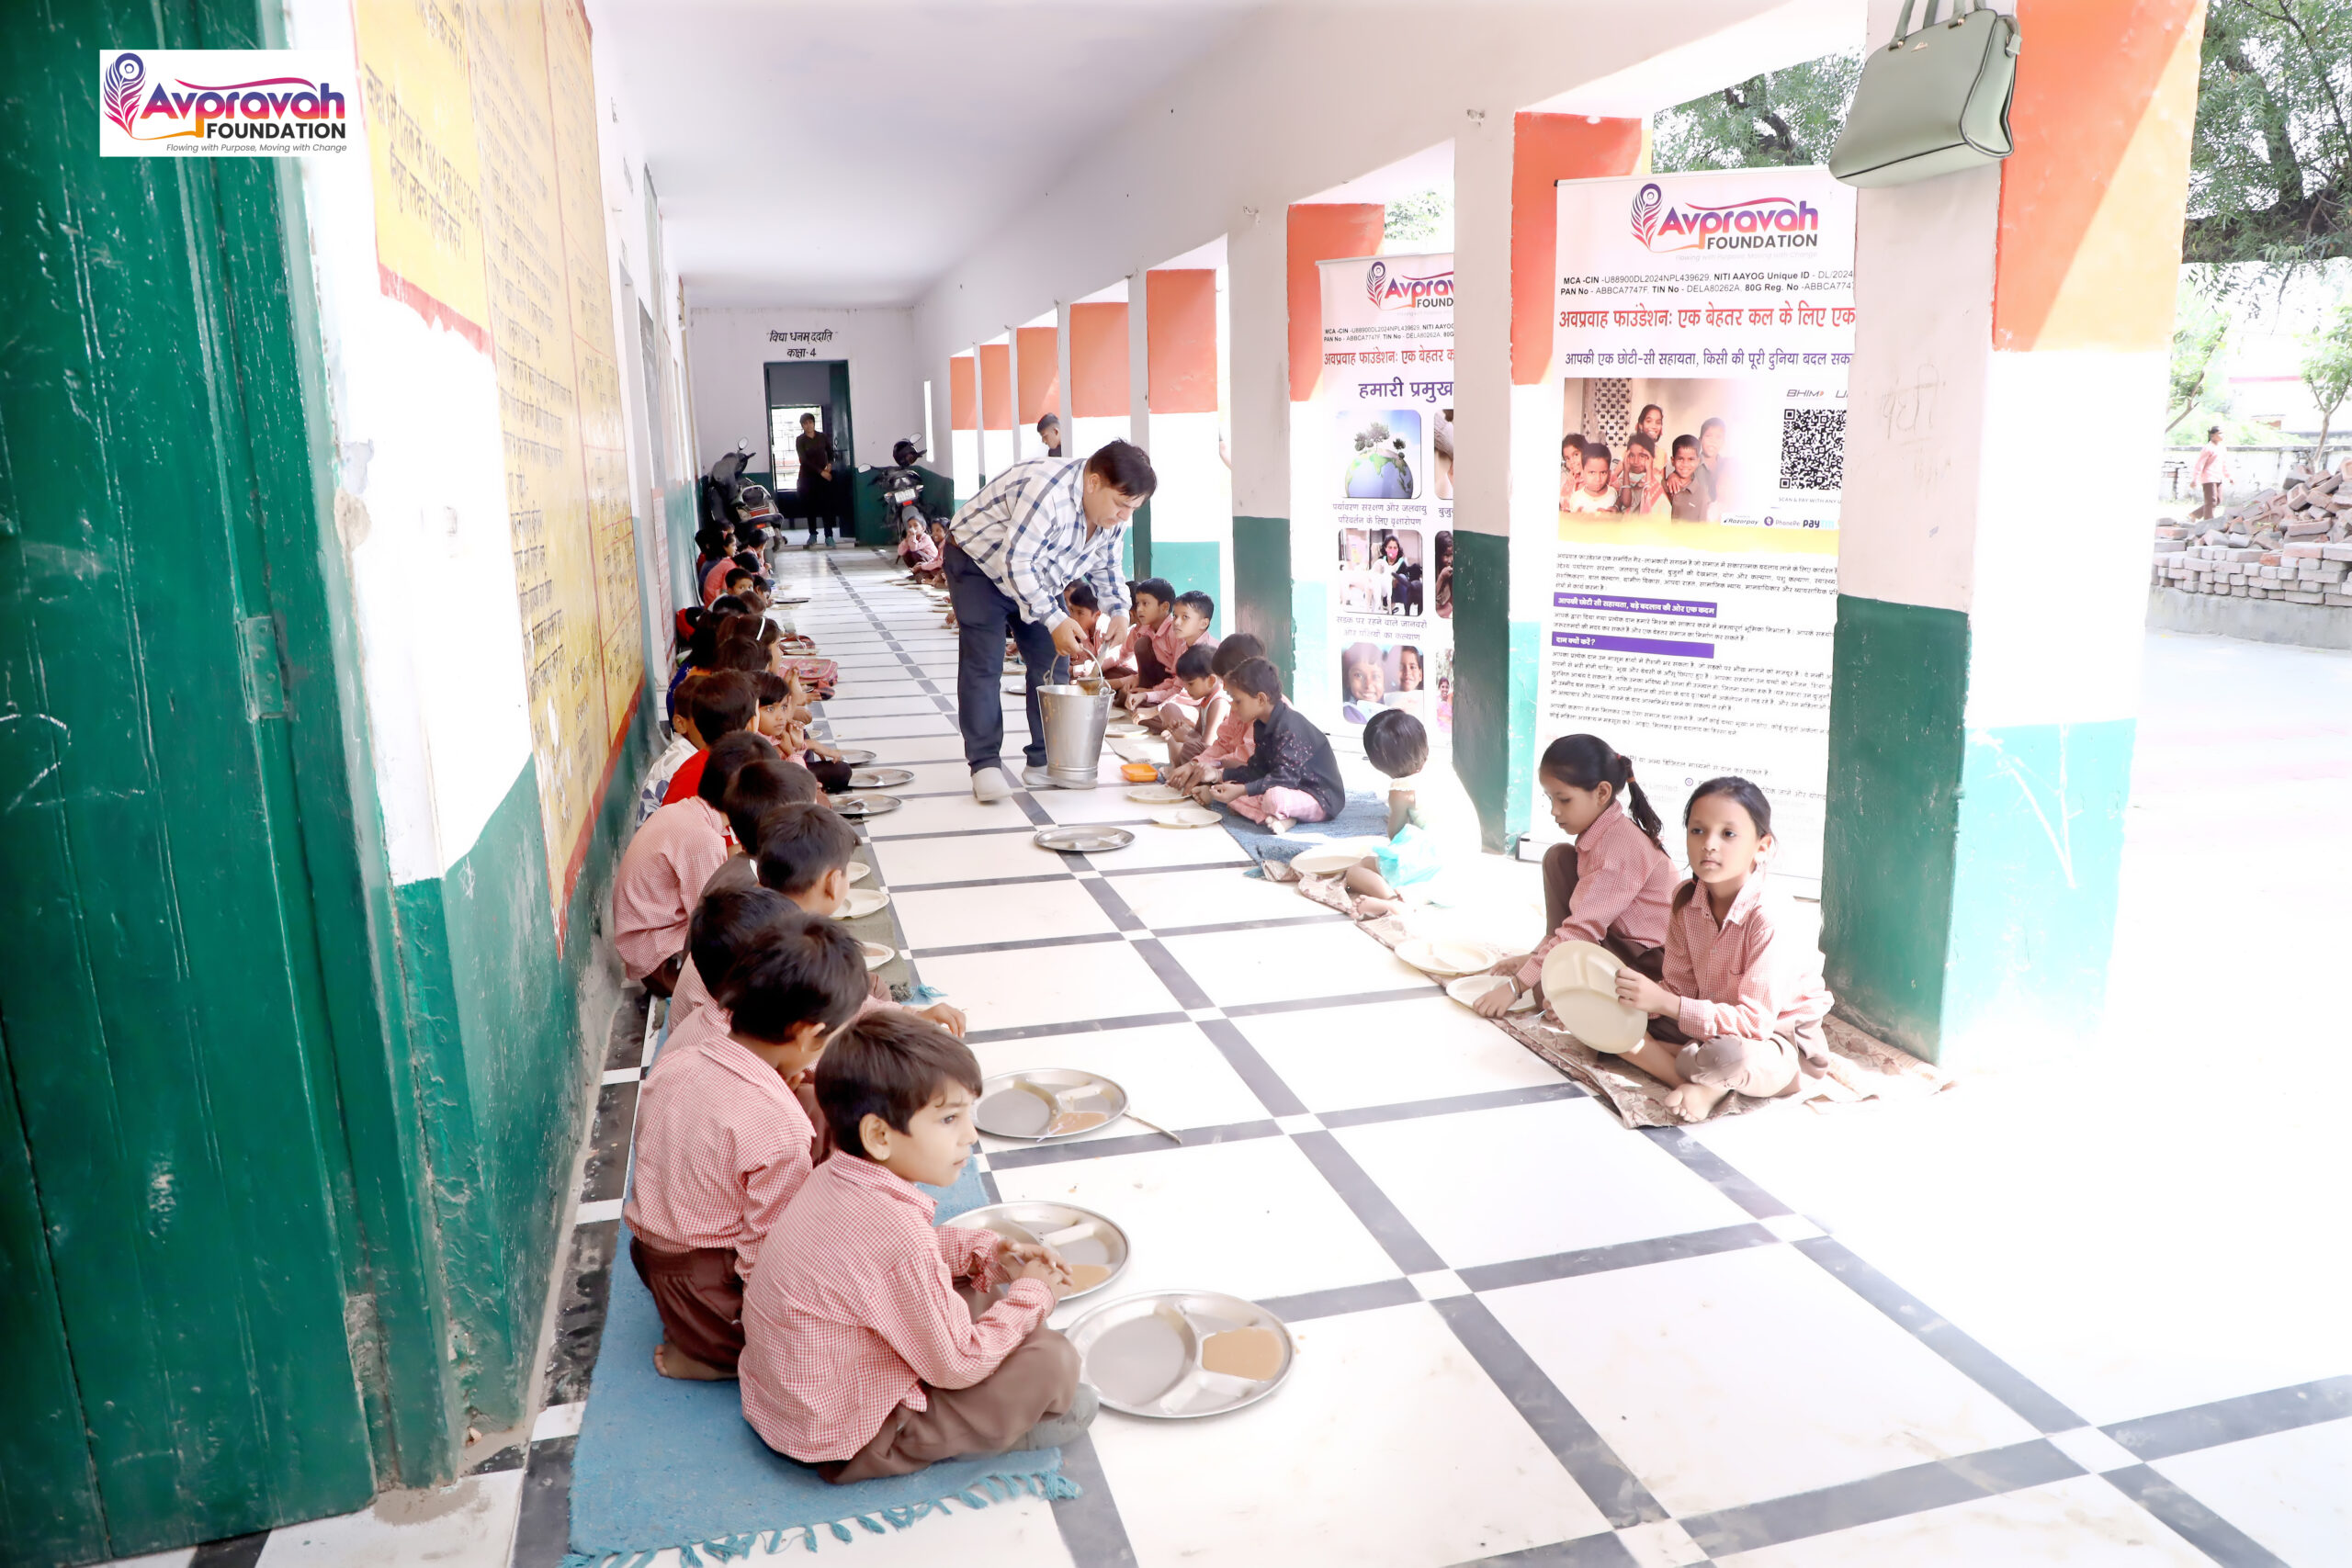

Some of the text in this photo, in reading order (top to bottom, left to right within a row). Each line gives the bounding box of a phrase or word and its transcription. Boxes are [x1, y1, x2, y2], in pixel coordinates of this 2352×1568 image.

[1657, 200, 1819, 247] Avpravah
[1707, 233, 1818, 250] FOUNDATION
[1563, 276, 1581, 285] MCA
[1713, 273, 1731, 281] NITI
[1732, 272, 1765, 280] AAYOG
[1767, 271, 1798, 281] Unique
[1800, 271, 1810, 279] ID
[1561, 288, 1577, 296] PAN
[1745, 284, 1762, 292] 80G
[1786, 283, 1799, 291] No
[1558, 310, 1610, 329] अवप्रवाह
[1677, 309, 1702, 328] एक
[1704, 300, 1745, 328] बेहतर
[1747, 308, 1775, 326] कल
[1778, 299, 1793, 326] के
[1797, 299, 1827, 327] लिए
[1832, 307, 1855, 327] एक
[769, 330, 788, 343] विद्या
[811, 329, 833, 343] ददाति
[1324, 352, 1357, 366] अवप्रवाह
[1400, 349, 1417, 365] एक
[1418, 344, 1444, 364] बेहतर
[1565, 348, 1595, 365] आपकी
[1597, 353, 1614, 366] एक
[1702, 347, 1728, 365] किसी
[1731, 347, 1745, 365] की
[1747, 347, 1766, 369] पूरी
[1768, 347, 1800, 370] दुनिया
[1802, 353, 1827, 366] बदल
[1830, 353, 1854, 365] सक
[1358, 376, 1405, 399] हमारी
[1786, 389, 1820, 398] BHIM
[1558, 596, 1578, 605] आपकी
[1662, 603, 1671, 612] की
[1685, 605, 1697, 614] एक
